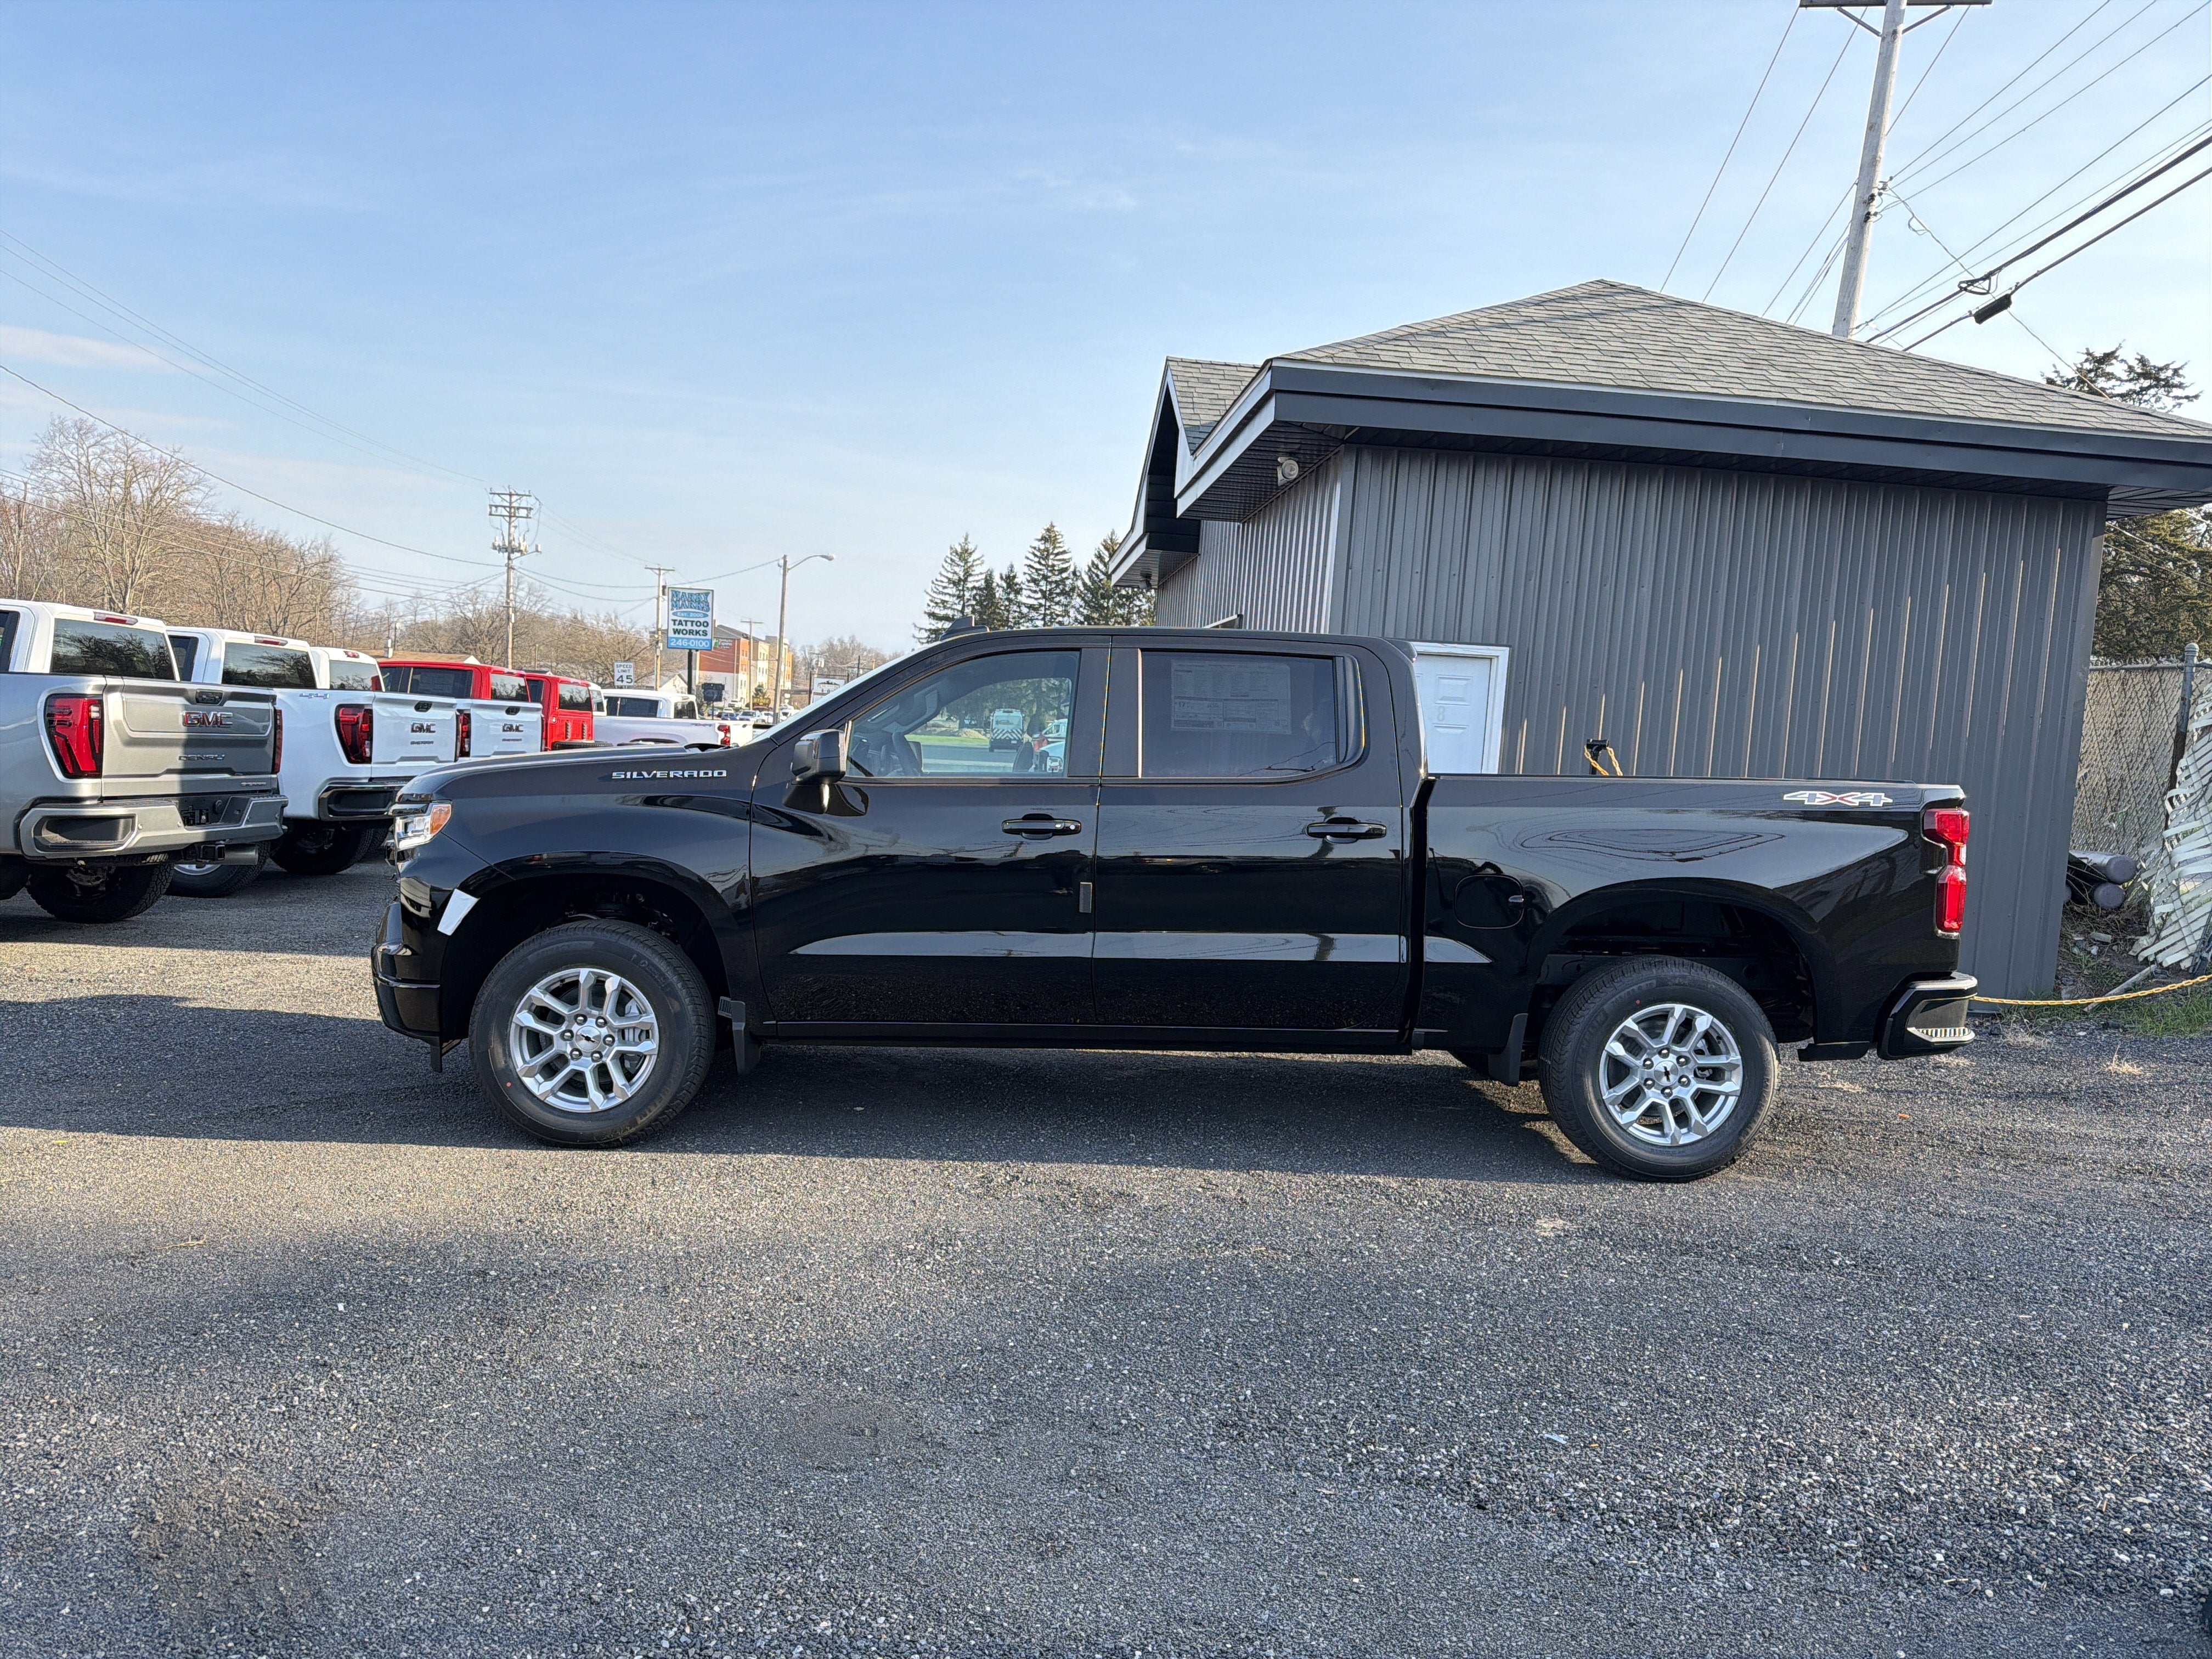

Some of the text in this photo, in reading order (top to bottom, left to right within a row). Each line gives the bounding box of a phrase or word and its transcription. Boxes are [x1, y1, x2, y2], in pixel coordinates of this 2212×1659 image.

[670, 590, 710, 602] MARKY
[671, 619, 709, 628] TATTOO
[672, 628, 708, 636] WORKS
[670, 639, 710, 647] 246-0100
[616, 674, 633, 684] 45
[182, 710, 233, 728] GMC
[1437, 706, 1446, 722] 8
[410, 721, 436, 733] GMC
[502, 723, 524, 732] GMC
[611, 769, 727, 780] SILVERADO
